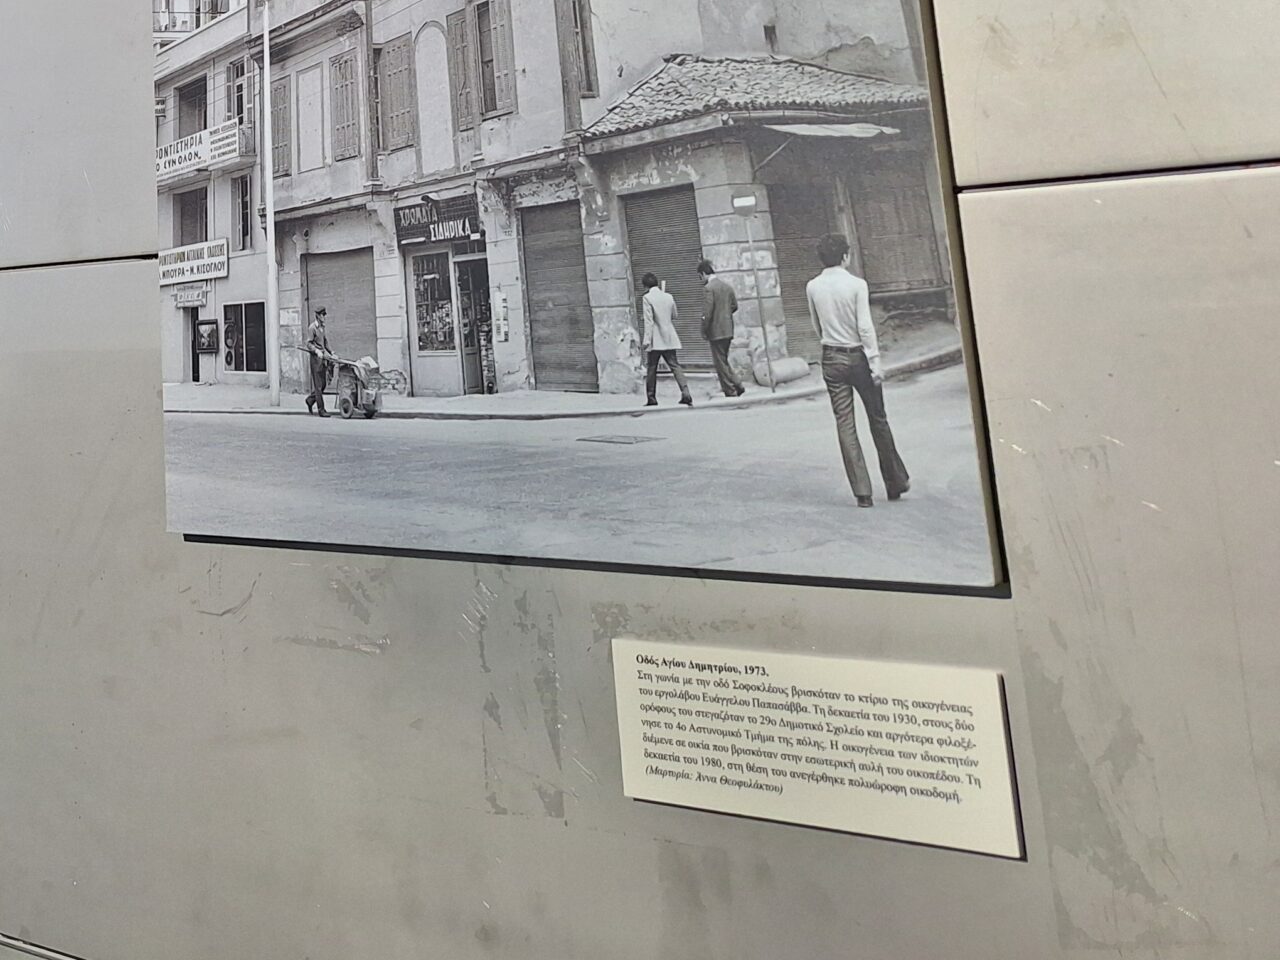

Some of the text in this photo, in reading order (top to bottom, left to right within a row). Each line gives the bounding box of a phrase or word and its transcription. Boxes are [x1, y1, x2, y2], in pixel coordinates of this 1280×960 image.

[399, 203, 438, 226] ΧΡΩΜΑΤΑ
[429, 216, 472, 241] ΣΙΔΗΡΙΚΑ
[636, 655, 659, 668] Οδός
[661, 658, 686, 670] Αγίου
[688, 660, 742, 675] Δημητρίου,
[637, 671, 973, 716] Στη γωνία με την οδό Σοφοκλέους βρισκόταν το κτίριο της οικογένειας
[655, 689, 701, 702] εργολάβου
[702, 692, 750, 707] Ευάγγελου
[812, 704, 826, 718] Τη
[827, 706, 870, 720] δεκαετία
[872, 714, 890, 722] του
[893, 713, 921, 727] 1930,
[922, 719, 953, 732] στους
[955, 719, 975, 731] δύο
[640, 703, 676, 717] ορόφους
[678, 708, 693, 716] του
[695, 711, 745, 723] στεγαζόταν
[747, 716, 758, 724] το
[759, 715, 777, 726] 29ο
[779, 718, 824, 732] Δημοτικό
[826, 722, 865, 736] Σχολείο
[867, 730, 883, 739] και
[885, 732, 934, 746] αργότερα
[641, 720, 662, 729] νησε
[664, 722, 673, 730] το
[676, 722, 687, 731] 4ο
[689, 723, 742, 739] Αστυνομικό
[744, 729, 775, 744] Τμήμα
[777, 737, 794, 748] της
[830, 740, 839, 750] Η
[842, 744, 895, 757] οικογένεια
[898, 751, 917, 760] των
[921, 751, 979, 768] ιδιοκτητών
[643, 732, 674, 749] διέμενε
[688, 740, 710, 750] οικία
[712, 745, 729, 753] που
[731, 744, 778, 759] βρισκόταν
[780, 754, 803, 765] στην
[805, 757, 856, 772] εσωτερική
[858, 762, 884, 776] αυλή
[886, 767, 904, 776] του
[906, 769, 963, 783] οικοπέδου.
[966, 774, 981, 788] Τη
[644, 748, 681, 763] δεκαετία
[683, 757, 698, 765] του
[701, 757, 725, 770] 1980,
[727, 763, 744, 774] στη
[746, 762, 769, 778] θέση
[771, 769, 787, 777] του
[790, 771, 846, 786] ανεγέρθηκε
